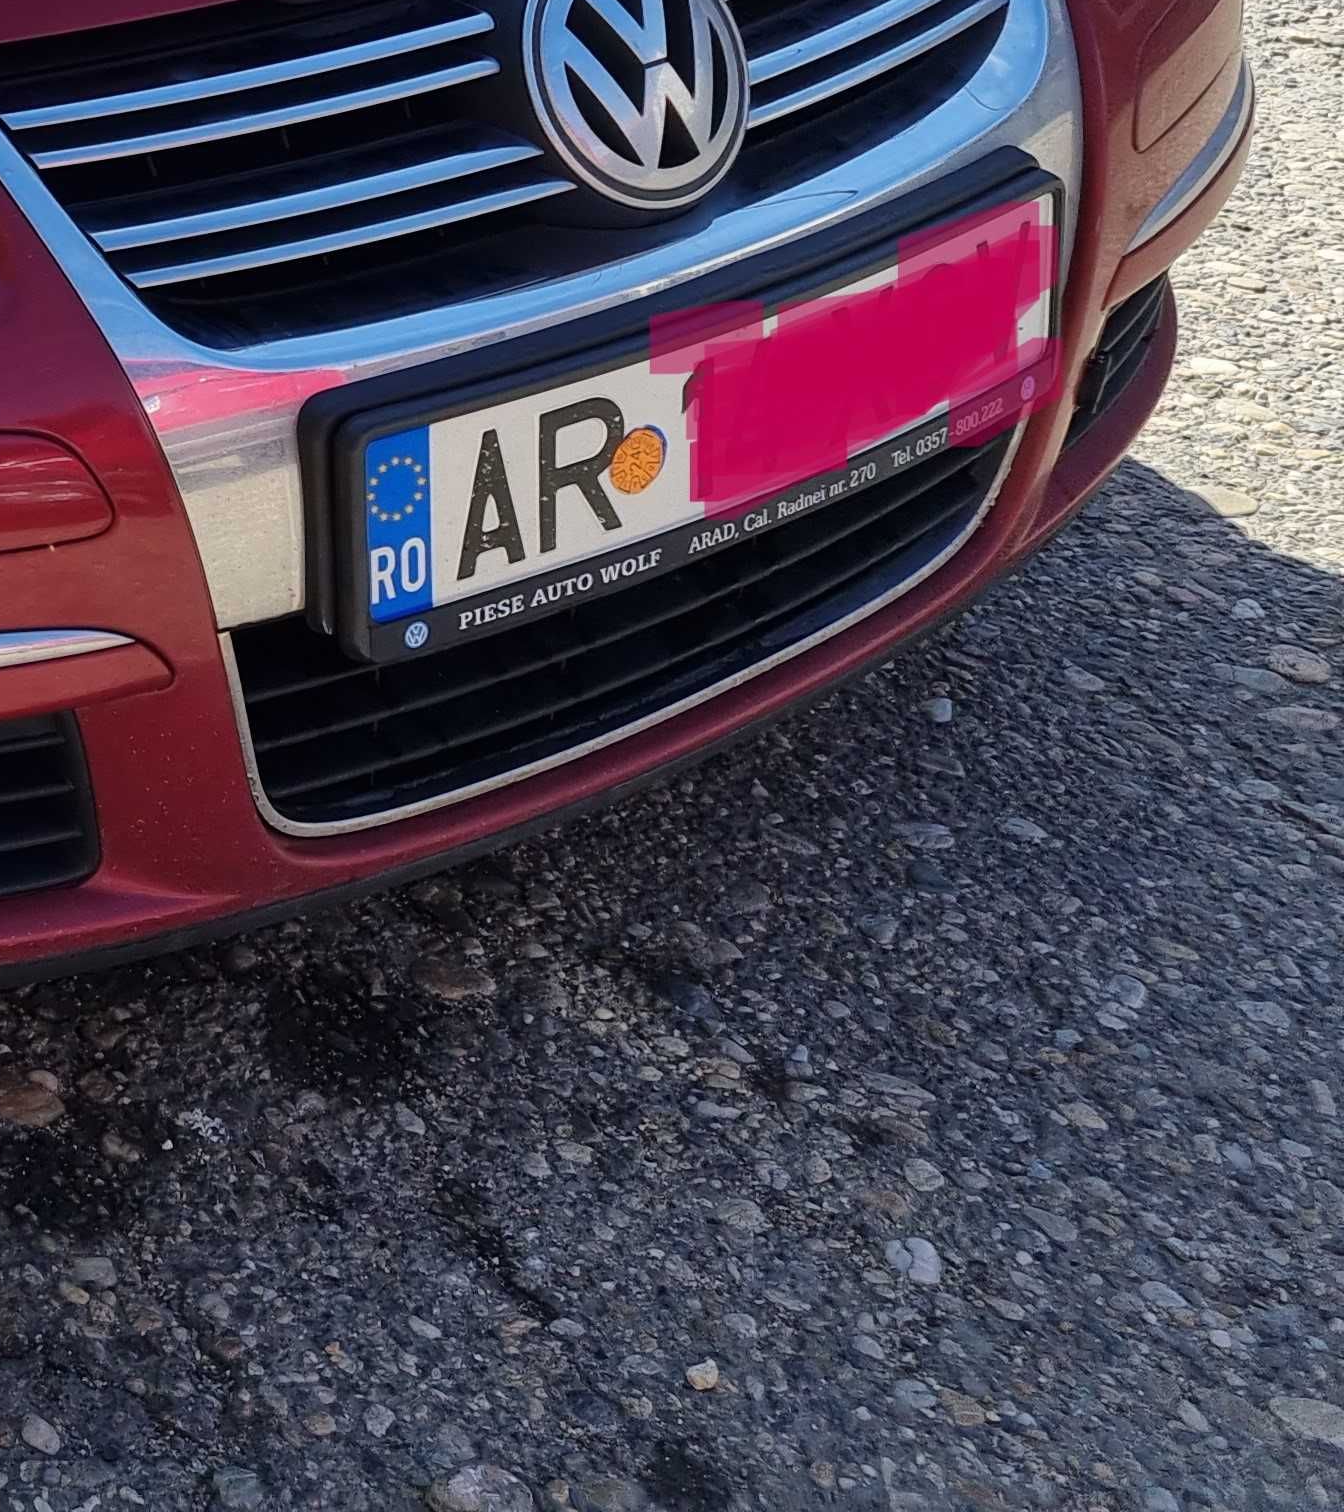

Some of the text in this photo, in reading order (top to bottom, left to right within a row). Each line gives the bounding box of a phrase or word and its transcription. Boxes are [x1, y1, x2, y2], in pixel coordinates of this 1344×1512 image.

[370, 536, 427, 605] RO
[456, 396, 625, 581] AR
[458, 594, 525, 631] PIESE
[530, 572, 594, 608] AUTO
[599, 548, 663, 584] WOLF
[687, 522, 740, 555] ARAD,
[743, 508, 773, 532] Cal.
[776, 484, 826, 520] Radnei
[828, 479, 848, 498] nr.
[849, 462, 877, 488] 270
[890, 445, 914, 468] Tel.
